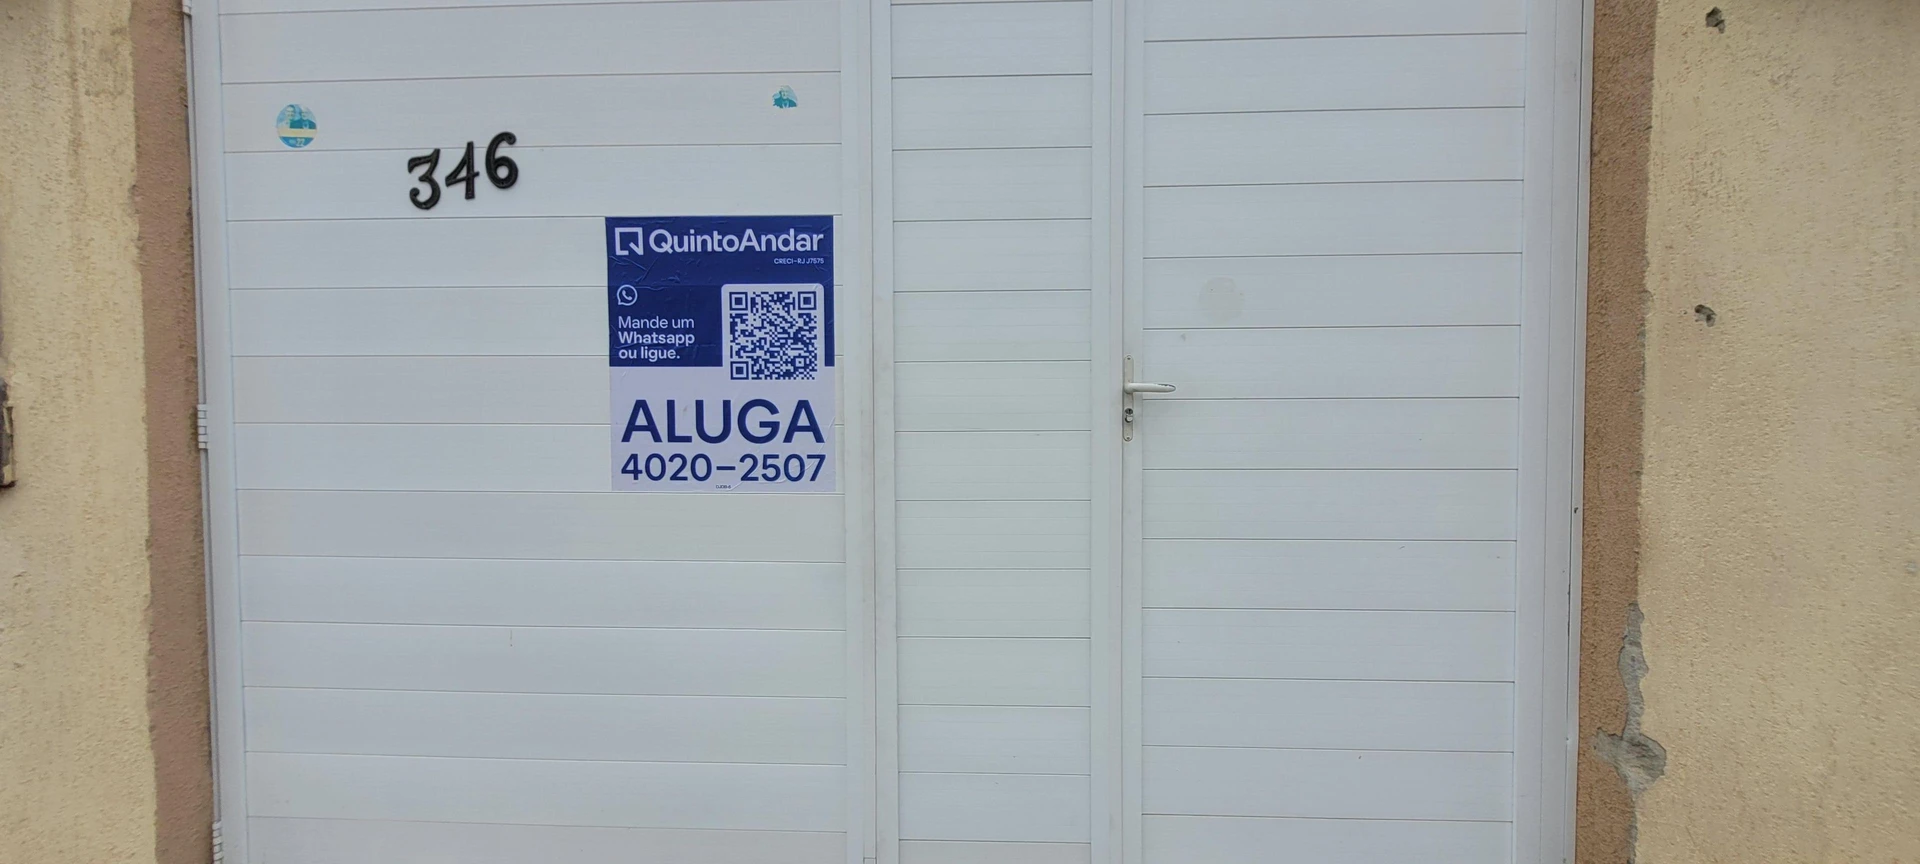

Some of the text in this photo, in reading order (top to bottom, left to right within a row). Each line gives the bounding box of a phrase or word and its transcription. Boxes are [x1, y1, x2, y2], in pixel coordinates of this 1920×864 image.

[407, 131, 520, 211] 346
[648, 228, 824, 254] QuintoAndar
[618, 315, 695, 329] Mande um
[618, 331, 695, 347] Whatsapp
[618, 346, 681, 362] ou ligue.
[621, 399, 825, 444] ALUGA
[621, 453, 827, 482] 4020-2507
